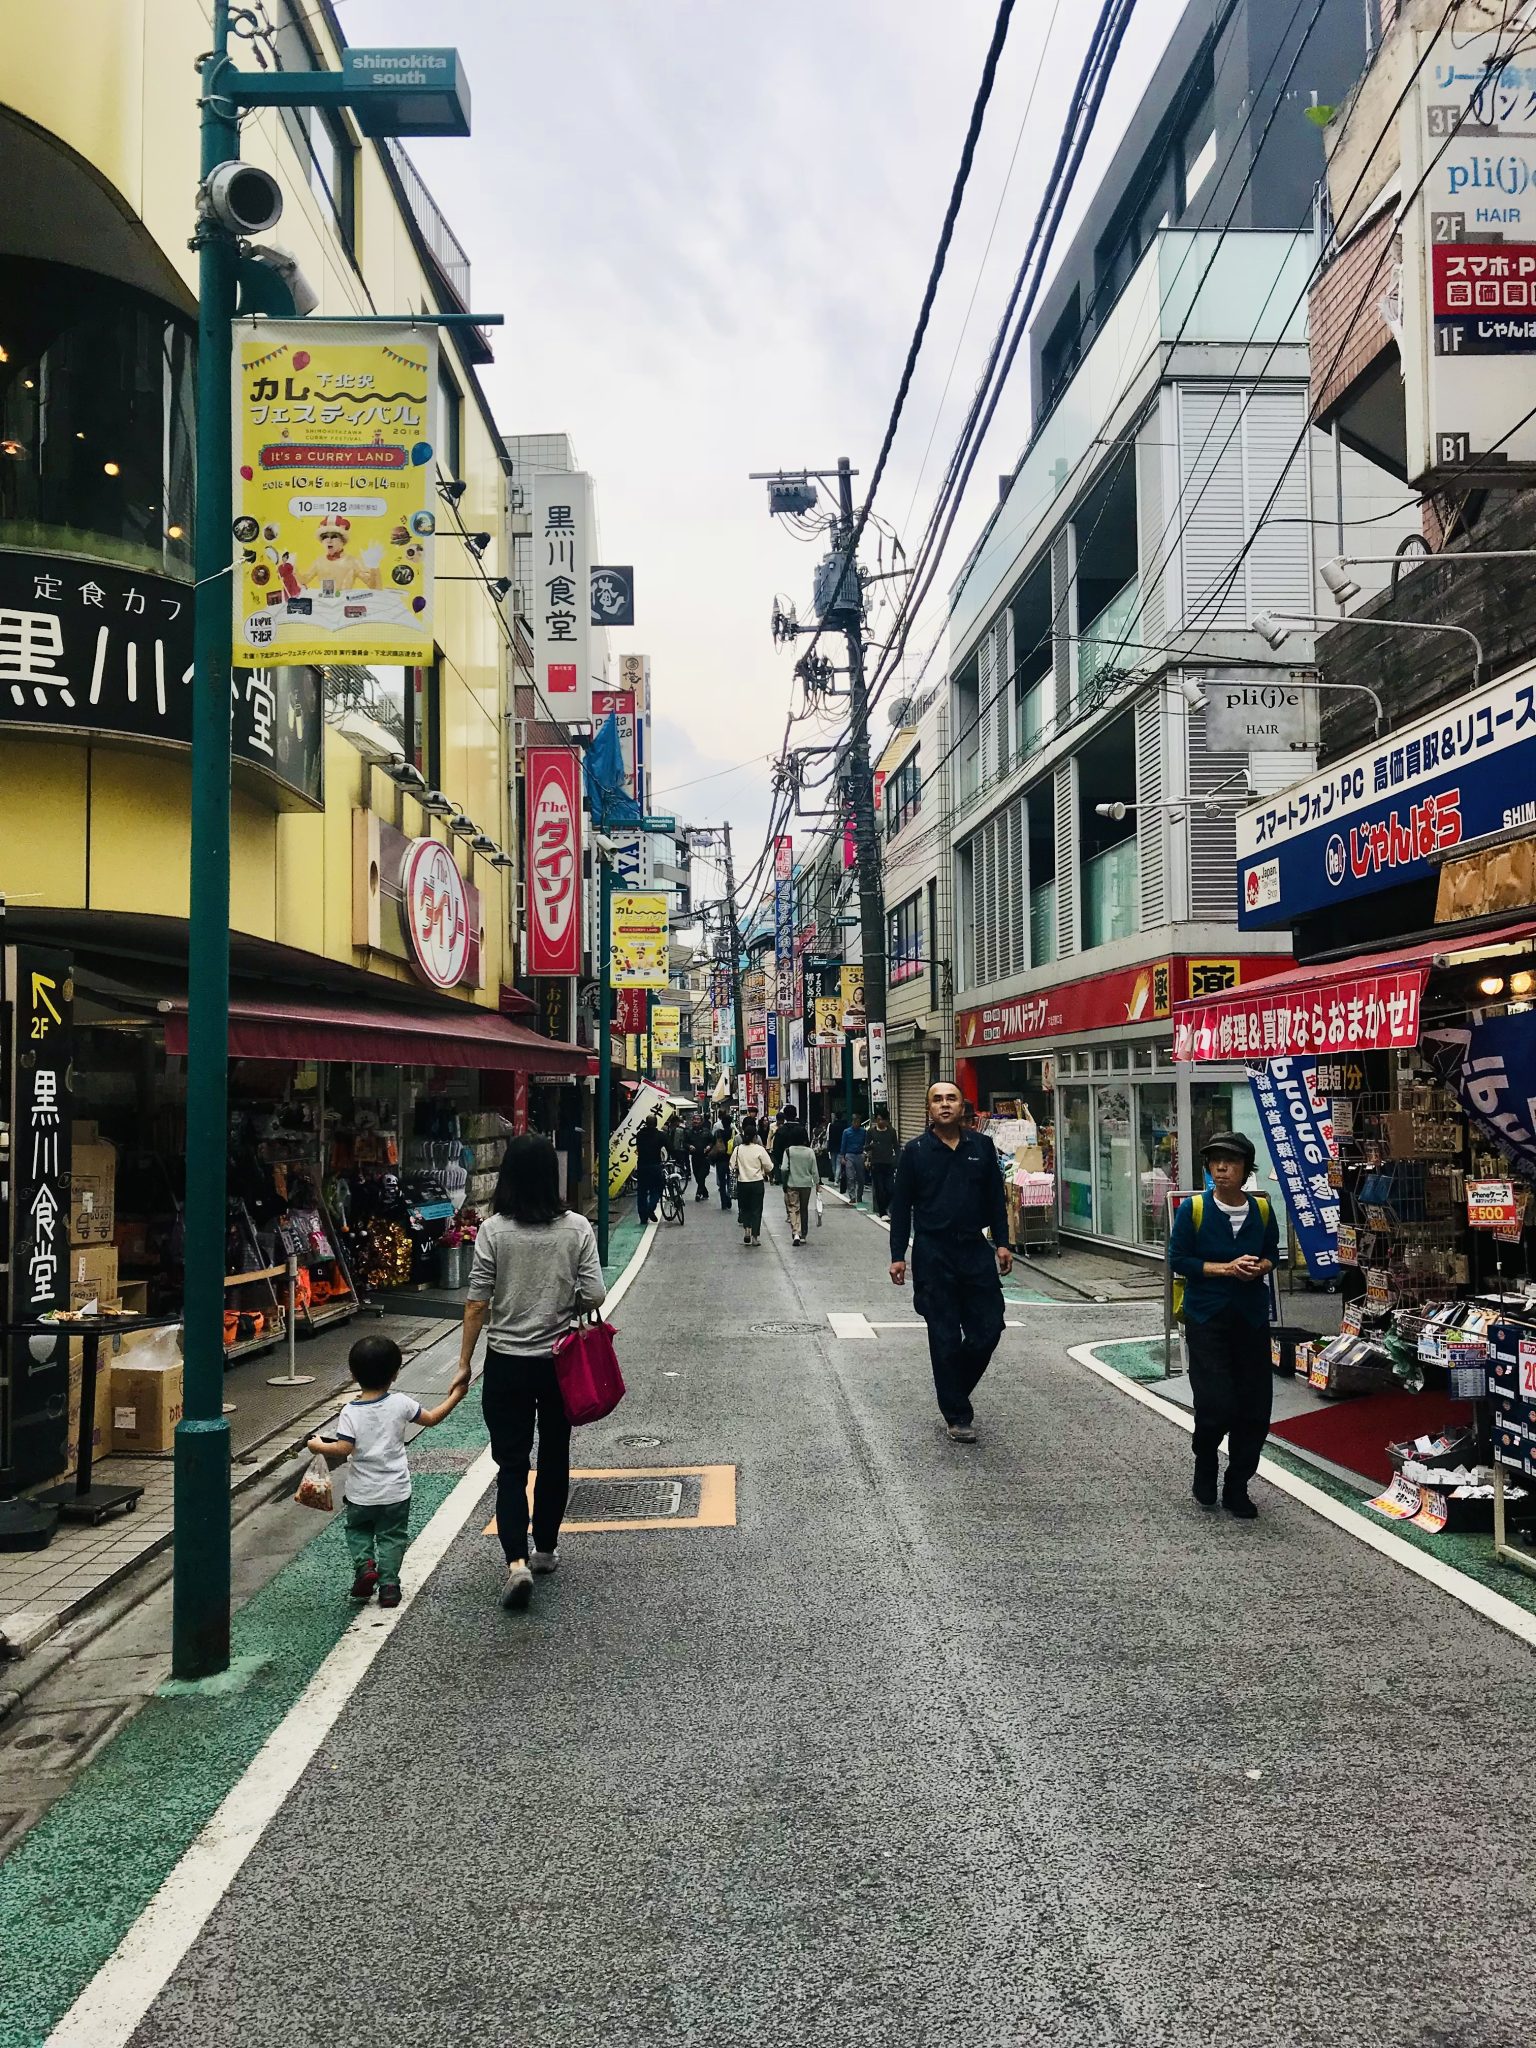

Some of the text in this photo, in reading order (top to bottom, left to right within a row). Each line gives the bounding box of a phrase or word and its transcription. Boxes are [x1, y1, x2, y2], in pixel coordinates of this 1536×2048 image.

[353, 54, 447, 69] shimokita
[373, 70, 426, 85] south
[1431, 108, 1458, 134] 3F
[1476, 208, 1521, 223] HAIR
[1436, 216, 1462, 241] 2F
[1447, 281, 1536, 306] 高価買
[1439, 326, 1464, 352] 1F
[316, 373, 376, 390] 下北沢
[250, 404, 421, 427] フェスティバル
[392, 428, 421, 436] 2018
[271, 452, 394, 463] It's a CURRY LAND
[1441, 436, 1466, 463] B1
[544, 505, 578, 642] 黒川食堂
[250, 630, 273, 643] 下北沢
[0, 608, 276, 757] 黒川堂
[602, 696, 626, 712] 2F
[1226, 685, 1299, 709] pli(j)e
[1246, 723, 1280, 735] HAIR
[539, 801, 568, 813] The
[1348, 787, 1463, 881] じゃんぱら
[436, 858, 448, 886] The
[536, 817, 573, 925] ダイソー
[1154, 967, 1168, 1011] 薬
[31, 1017, 49, 1040] 2F
[768, 1017, 776, 1036] AOKI
[1001, 998, 1049, 1036] ツルハドラッグ
[1316, 1064, 1364, 1091] 最短1分
[29, 1070, 60, 1303] 黒川食堂
[1469, 1206, 1504, 1221] ¥500
